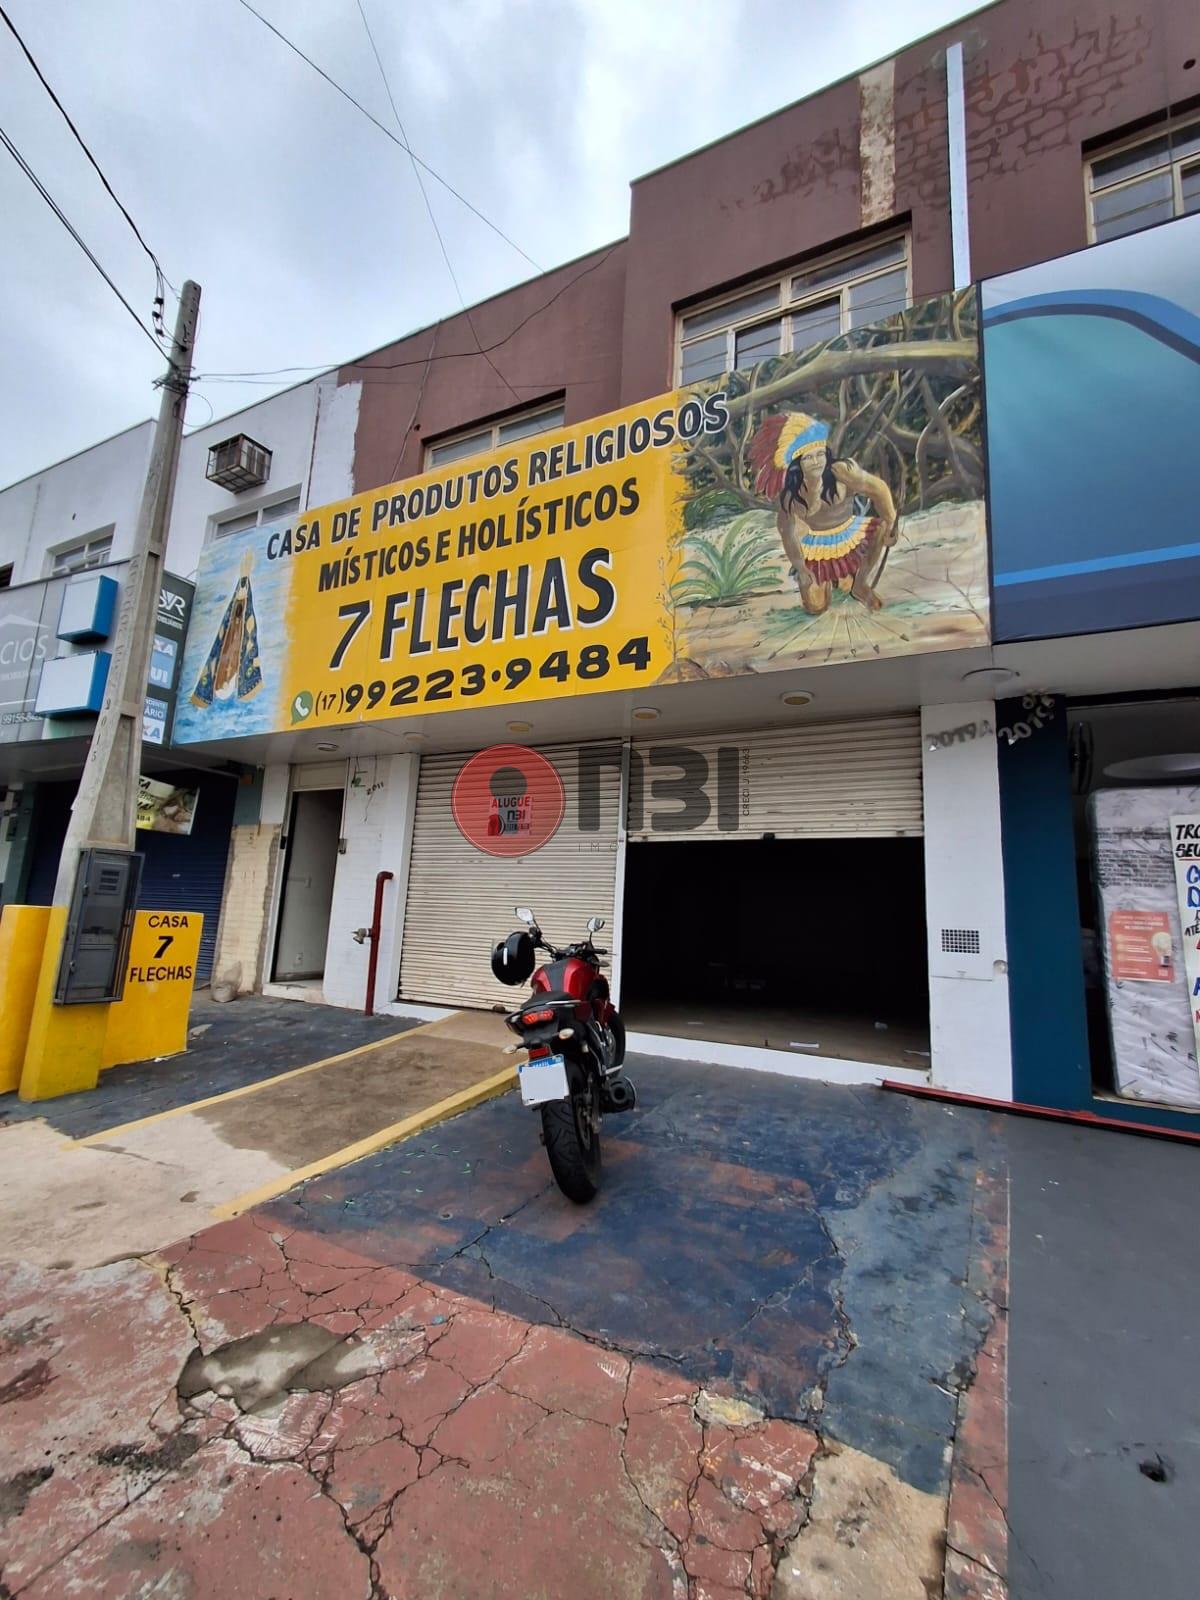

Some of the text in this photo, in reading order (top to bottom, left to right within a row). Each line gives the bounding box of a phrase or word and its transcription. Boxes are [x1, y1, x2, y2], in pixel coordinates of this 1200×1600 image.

[266, 391, 730, 561] CASA DE PRODUTOS RELIGIOSOS
[317, 477, 641, 593] MÍSTICOS E HOLÍSTICOS
[328, 547, 618, 672] 7 FLECHAS
[0, 634, 48, 665] CIOS
[148, 915, 189, 928] CASA
[153, 935, 175, 959] 7
[129, 965, 193, 983] FLECHAS
